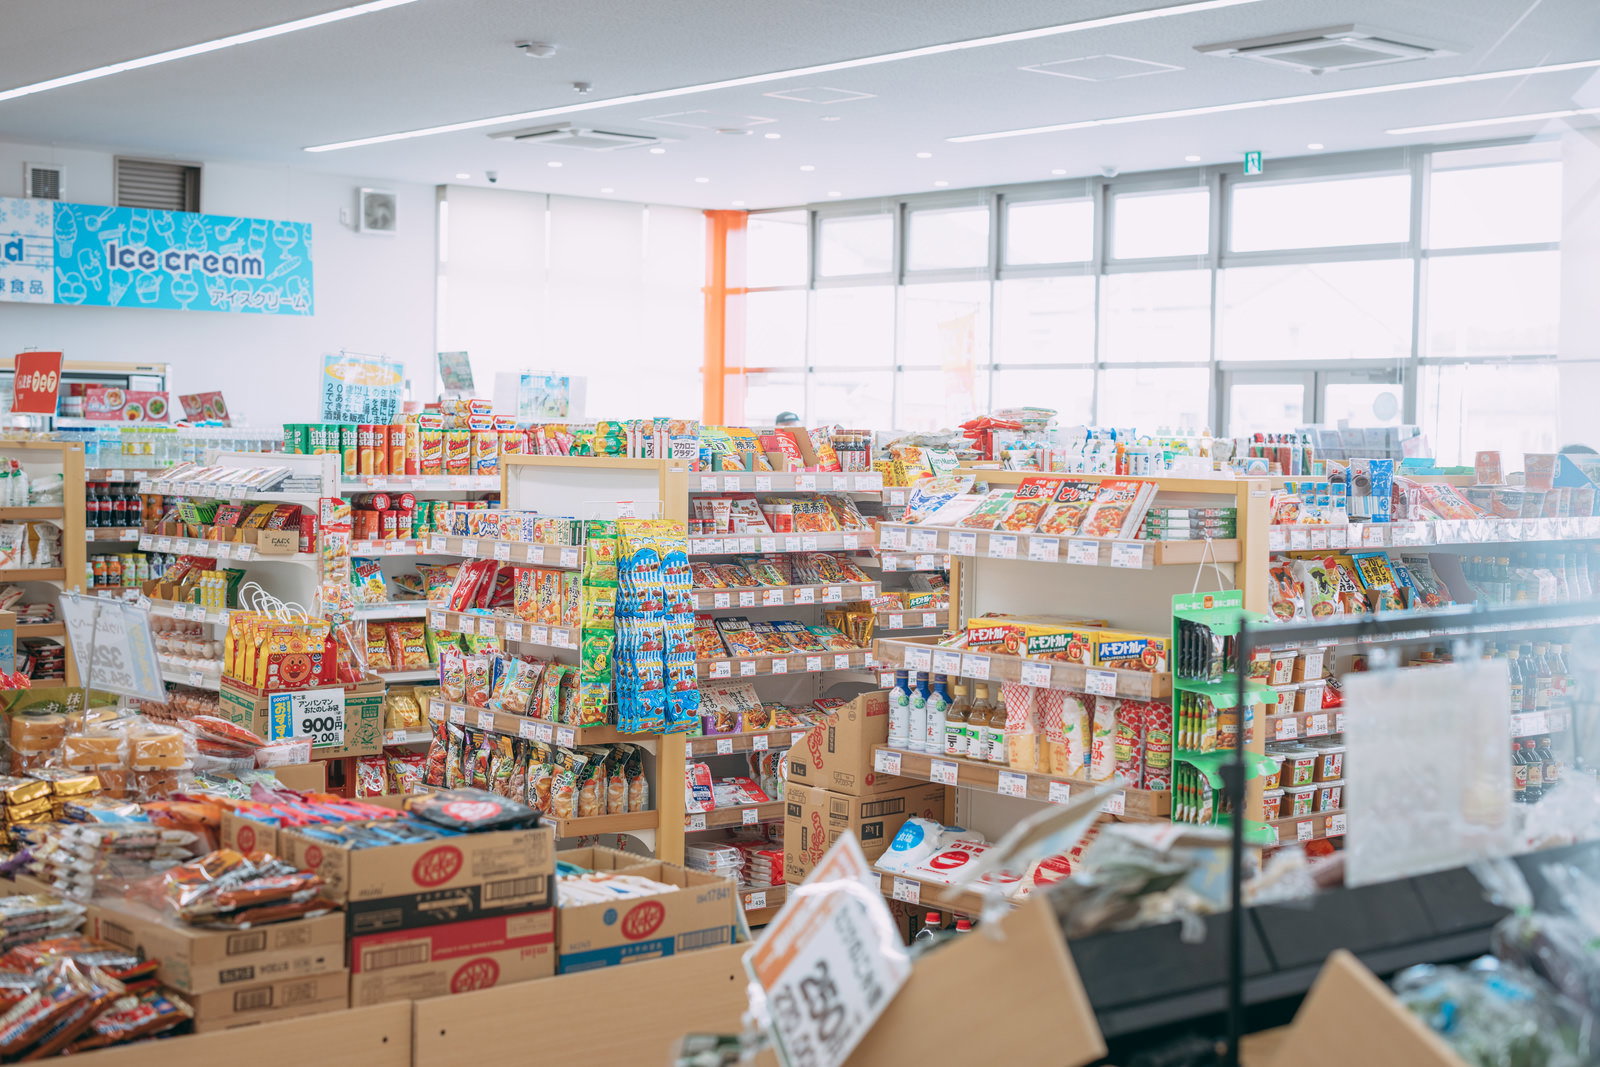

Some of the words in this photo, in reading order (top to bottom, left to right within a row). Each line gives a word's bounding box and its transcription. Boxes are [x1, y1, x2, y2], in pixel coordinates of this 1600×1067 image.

[0, 238, 23, 262] d
[109, 244, 156, 270] Ice
[165, 251, 262, 275] cream
[211, 290, 306, 308] アイスクリーム
[673, 442, 695, 450] マカロニ
[968, 627, 1009, 641] バーモントカレー
[1028, 633, 1073, 649] バーモントカレー
[1100, 641, 1146, 657] バーモントカレー
[299, 698, 333, 708] アンパンマン
[304, 704, 339, 714] おたのしみ袋
[302, 716, 335, 734] 900
[334, 721, 343, 731] 円
[865, 825, 880, 837] 1kg
